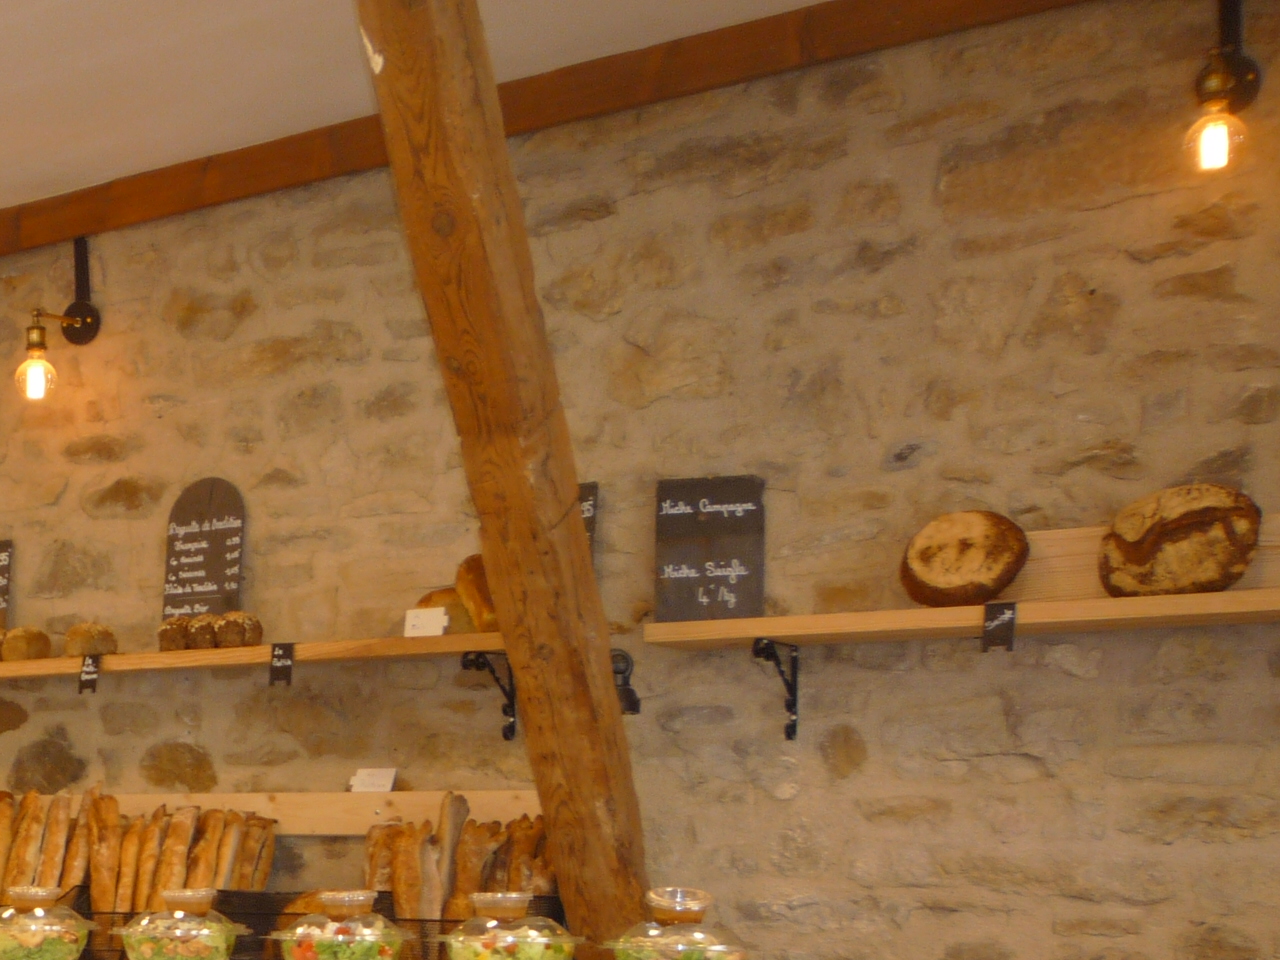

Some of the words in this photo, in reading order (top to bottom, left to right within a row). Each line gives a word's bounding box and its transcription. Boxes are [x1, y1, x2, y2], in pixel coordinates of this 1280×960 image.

[660, 499, 693, 514] Miche
[699, 499, 757, 517] Campagne
[660, 564, 700, 578] Miche
[705, 559, 749, 583] Seigle
